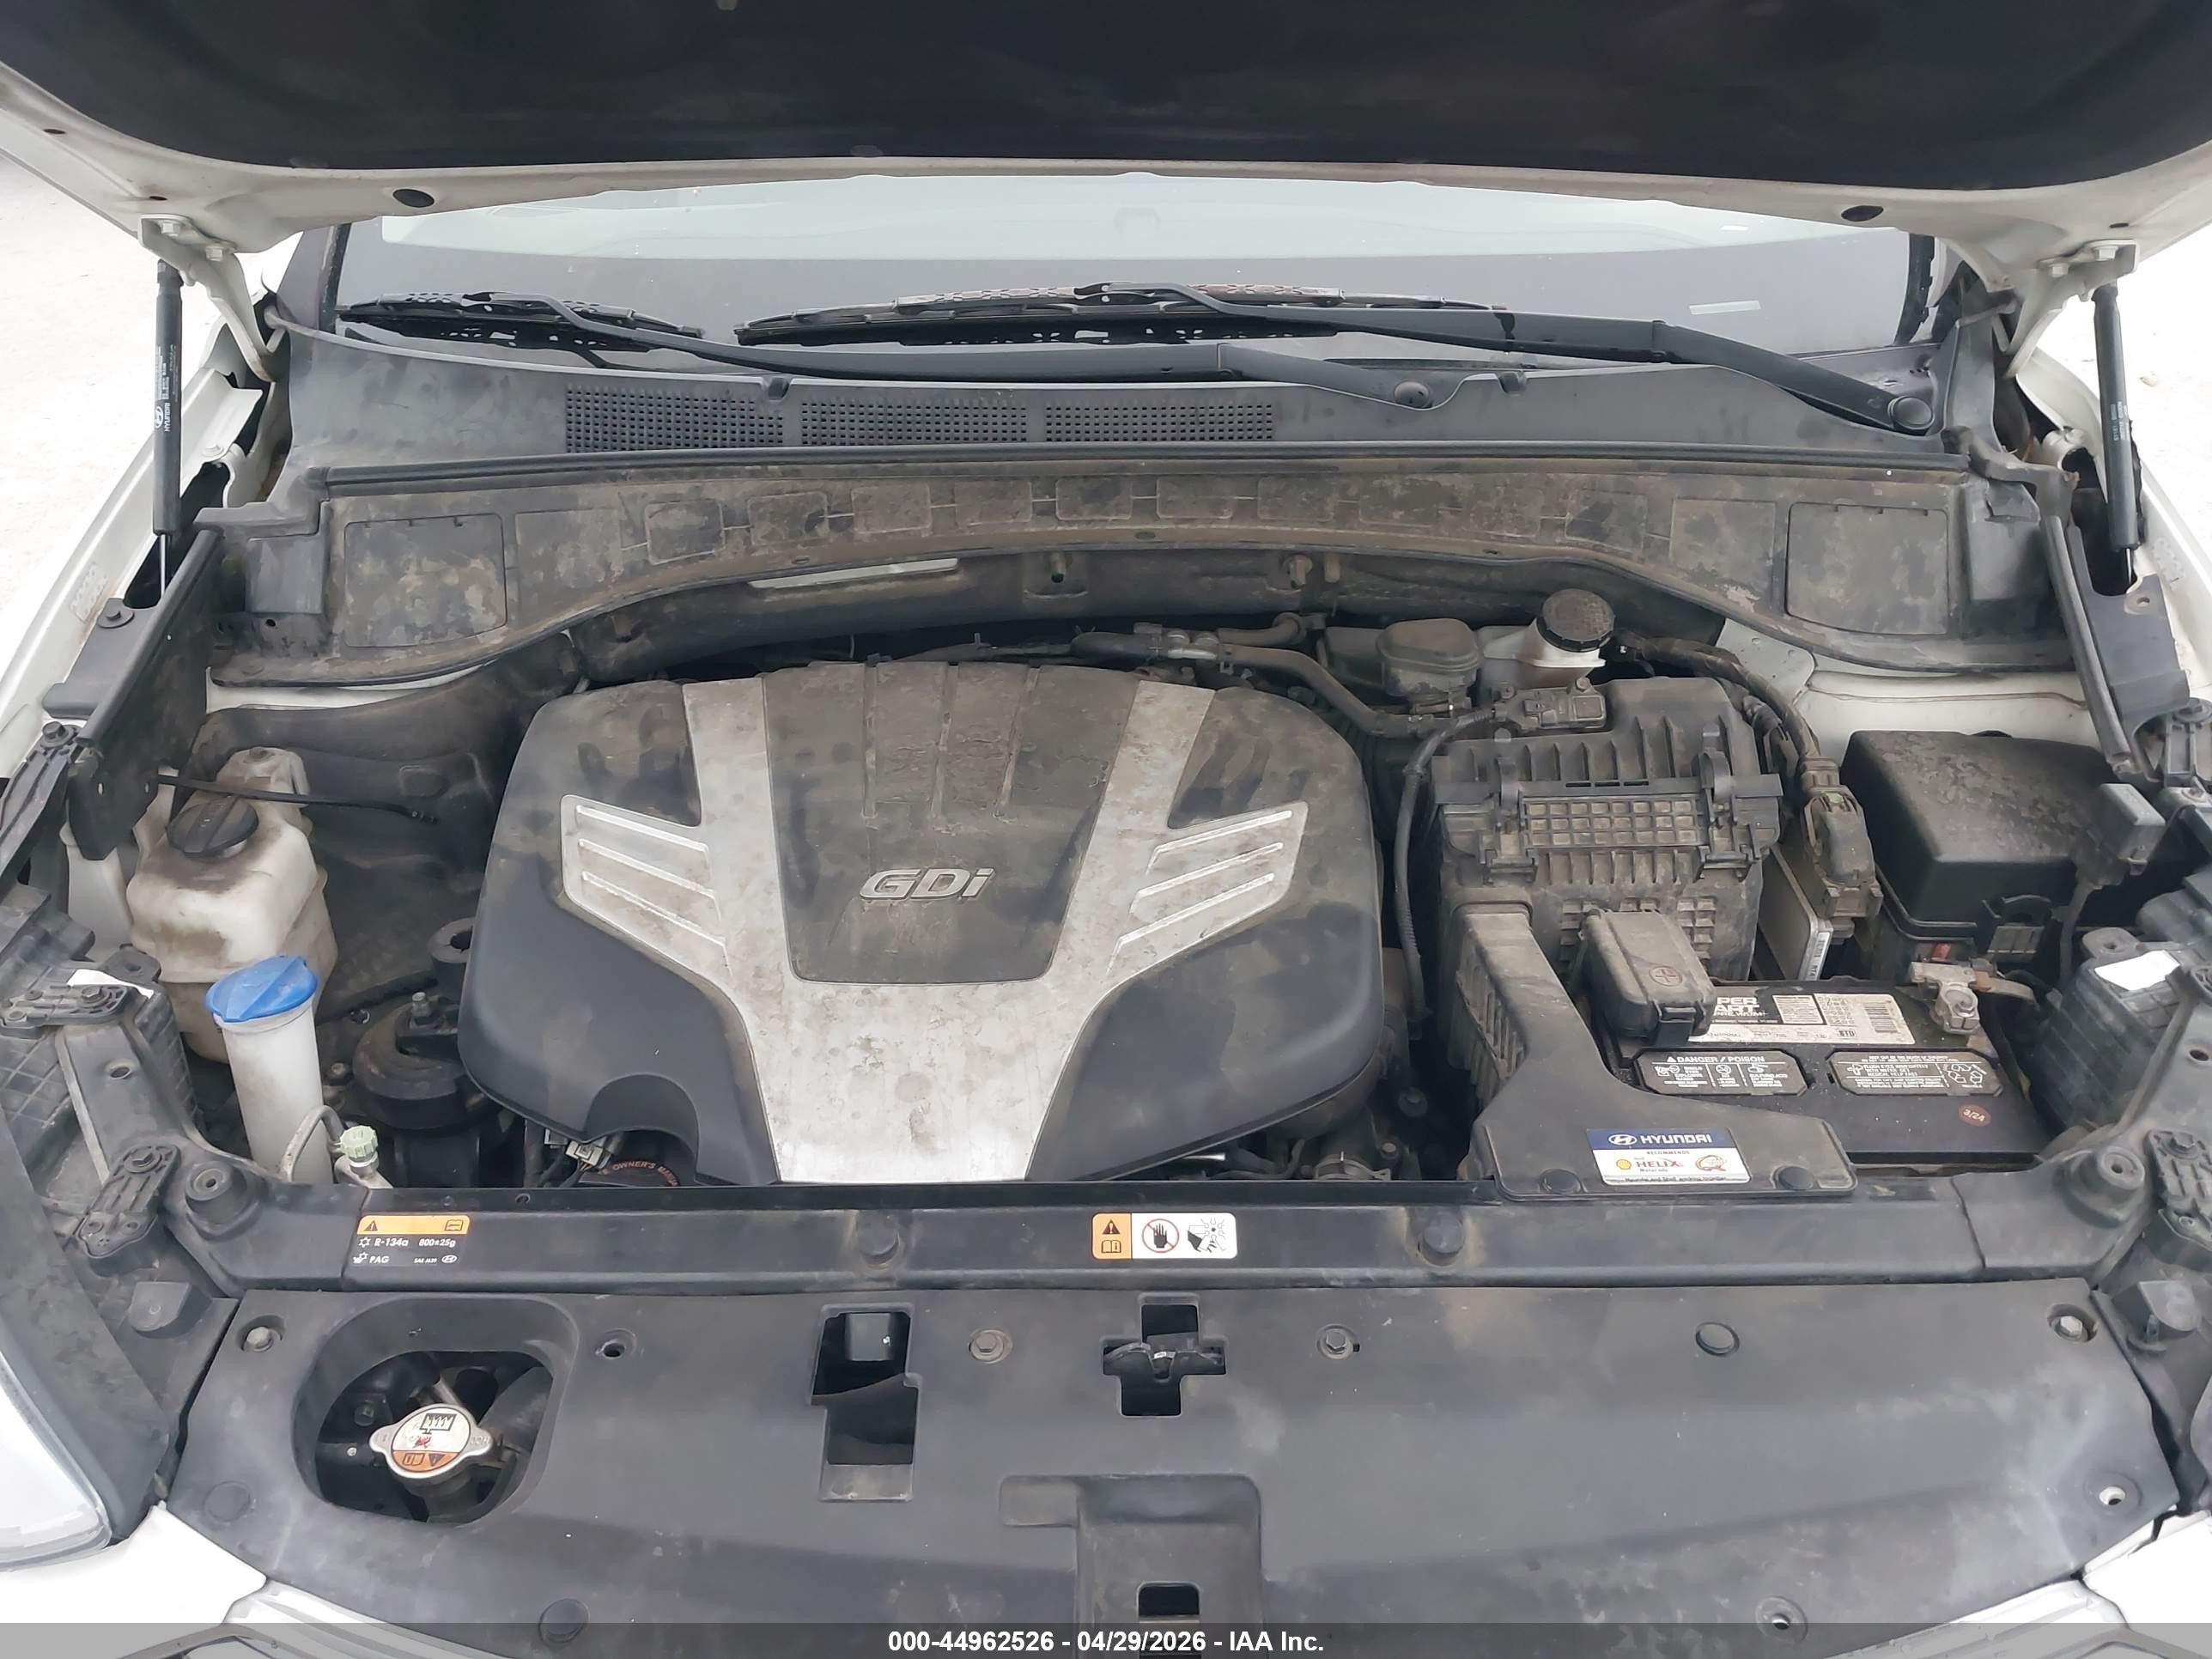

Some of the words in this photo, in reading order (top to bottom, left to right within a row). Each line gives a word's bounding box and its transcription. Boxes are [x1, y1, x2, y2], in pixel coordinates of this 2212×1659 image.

[860, 867, 995, 901] GDi
[1717, 996, 1758, 1005] PER
[1713, 1005, 1760, 1015] ART
[1640, 1133, 1713, 1145] HYUNDAI
[612, 1161, 657, 1170] OWNER'S
[374, 1237, 410, 1247] R-134a
